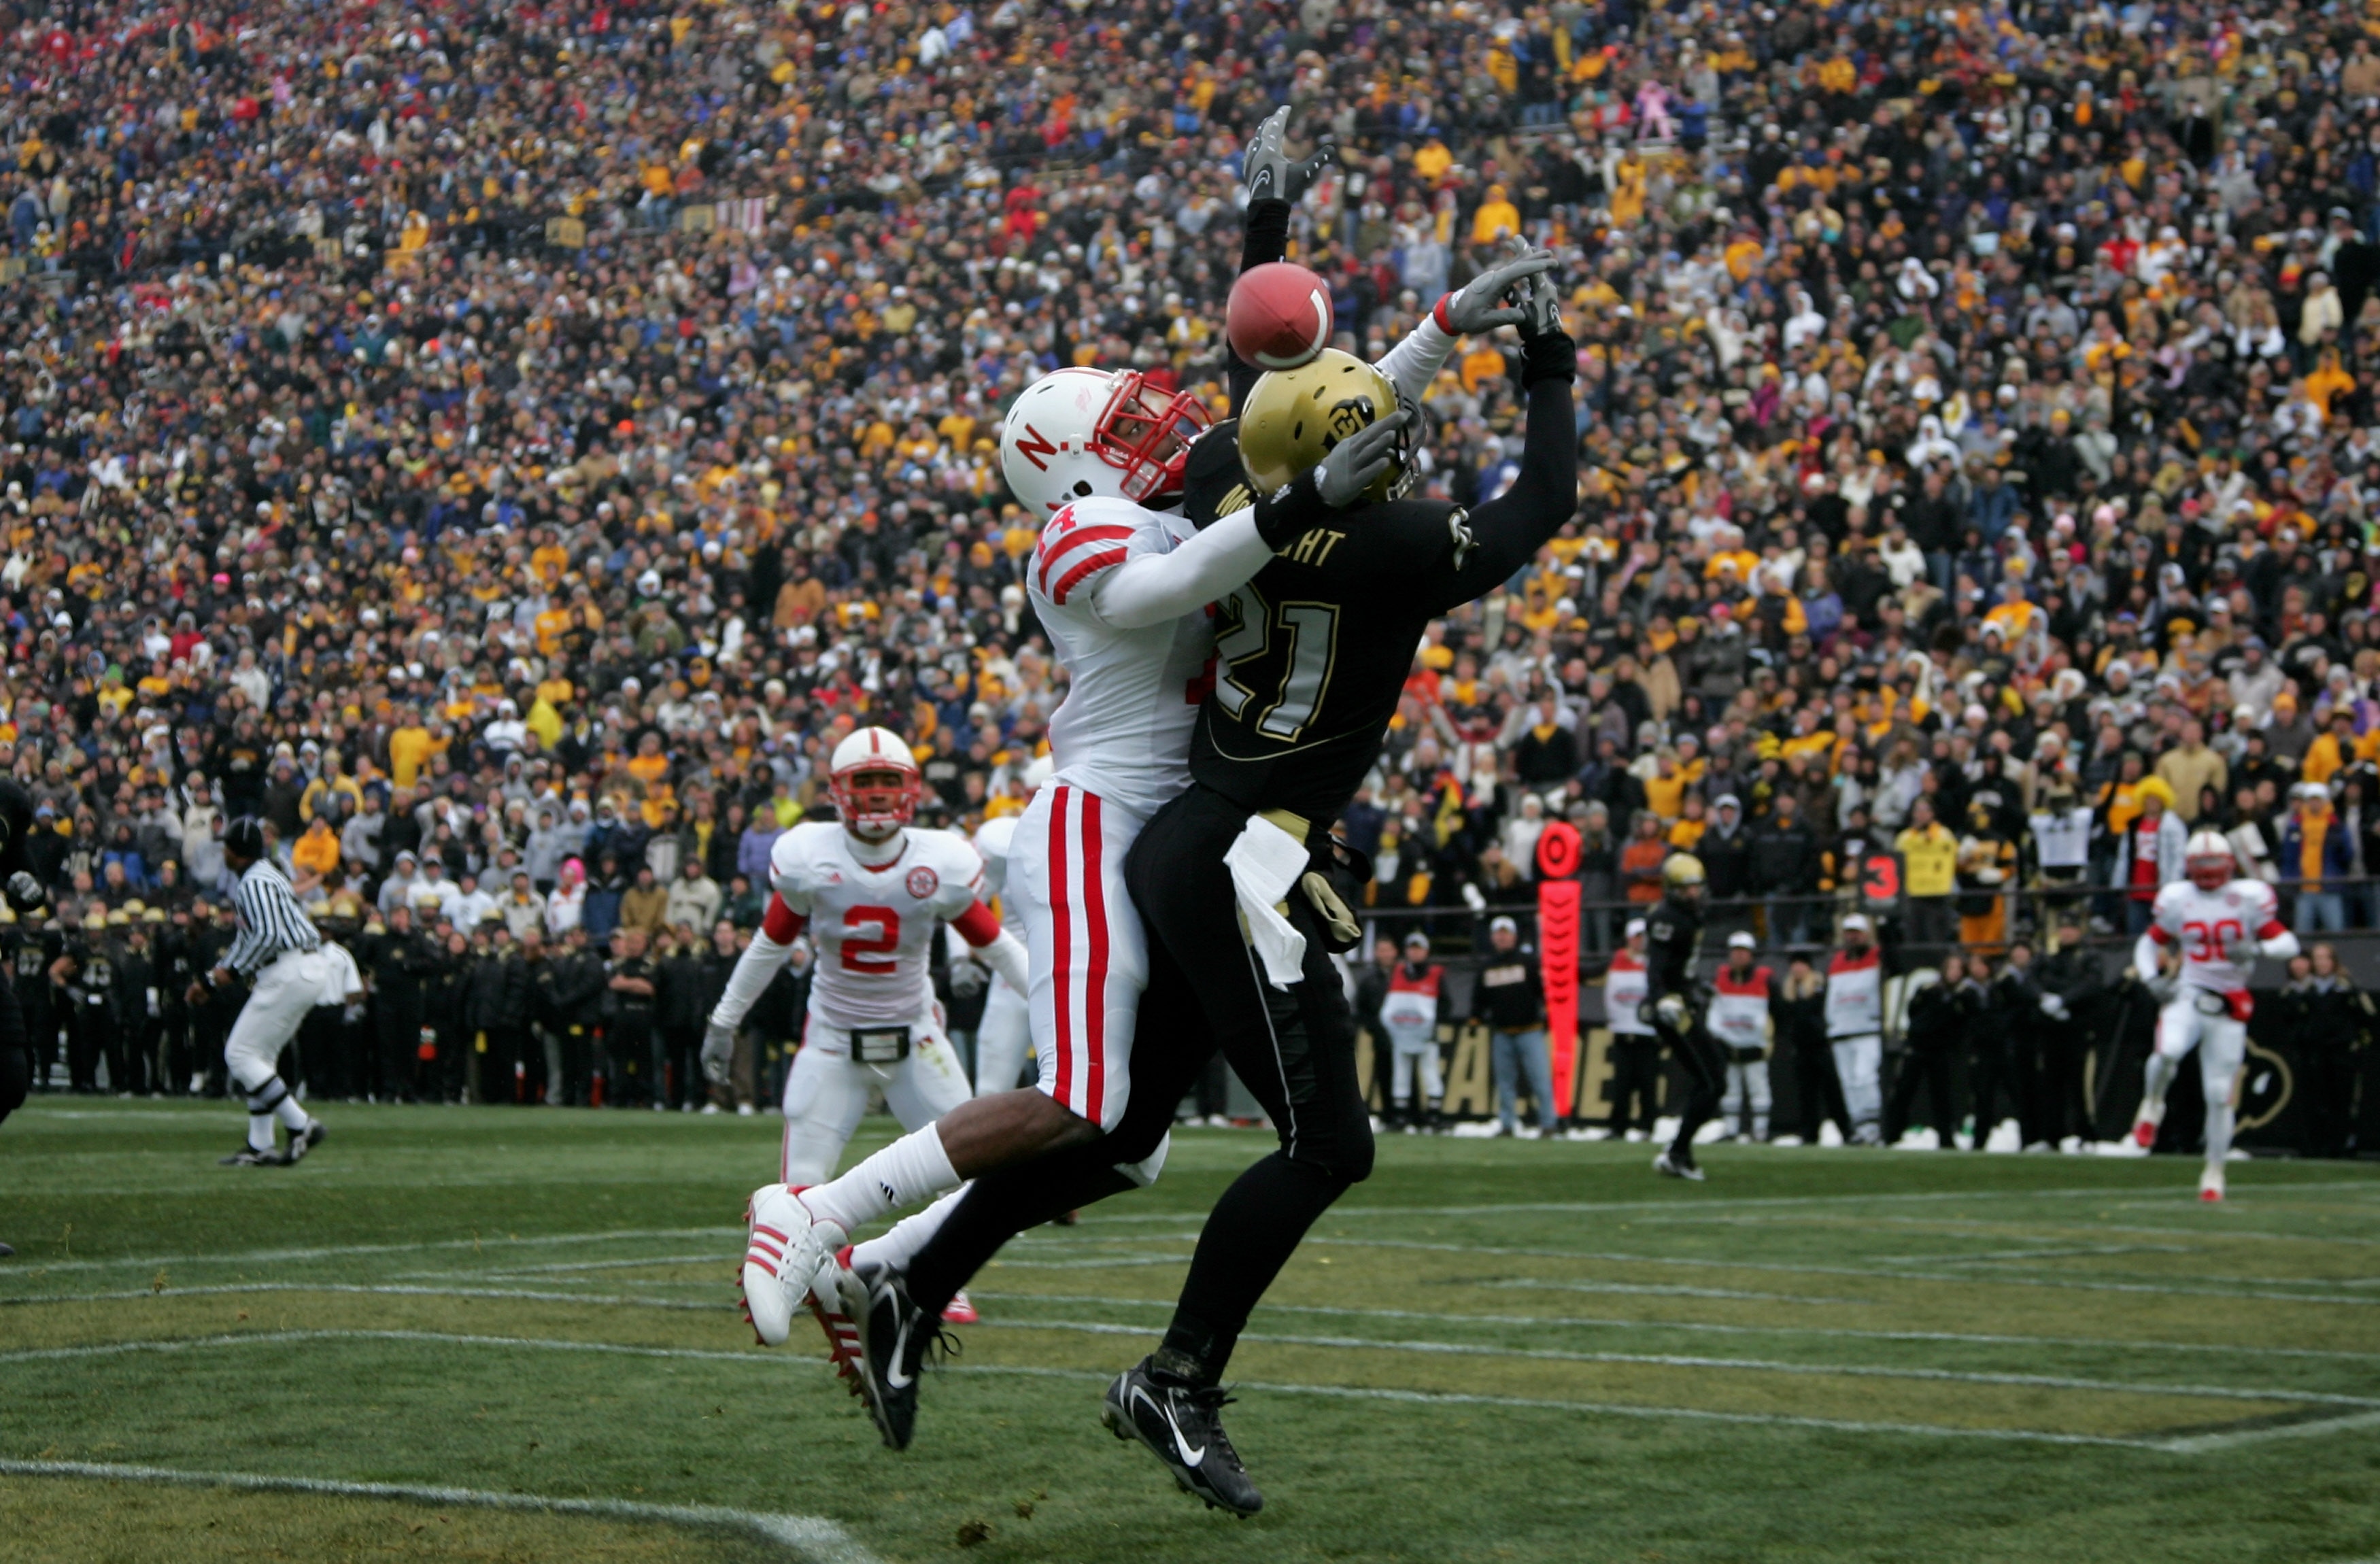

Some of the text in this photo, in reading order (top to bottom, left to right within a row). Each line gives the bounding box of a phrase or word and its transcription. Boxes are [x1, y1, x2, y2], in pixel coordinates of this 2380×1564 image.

[1015, 423, 1058, 472] N
[1214, 578, 1341, 743] 21
[1863, 855, 1901, 900] 3
[840, 905, 900, 975] 2
[2182, 919, 2245, 963] 30
